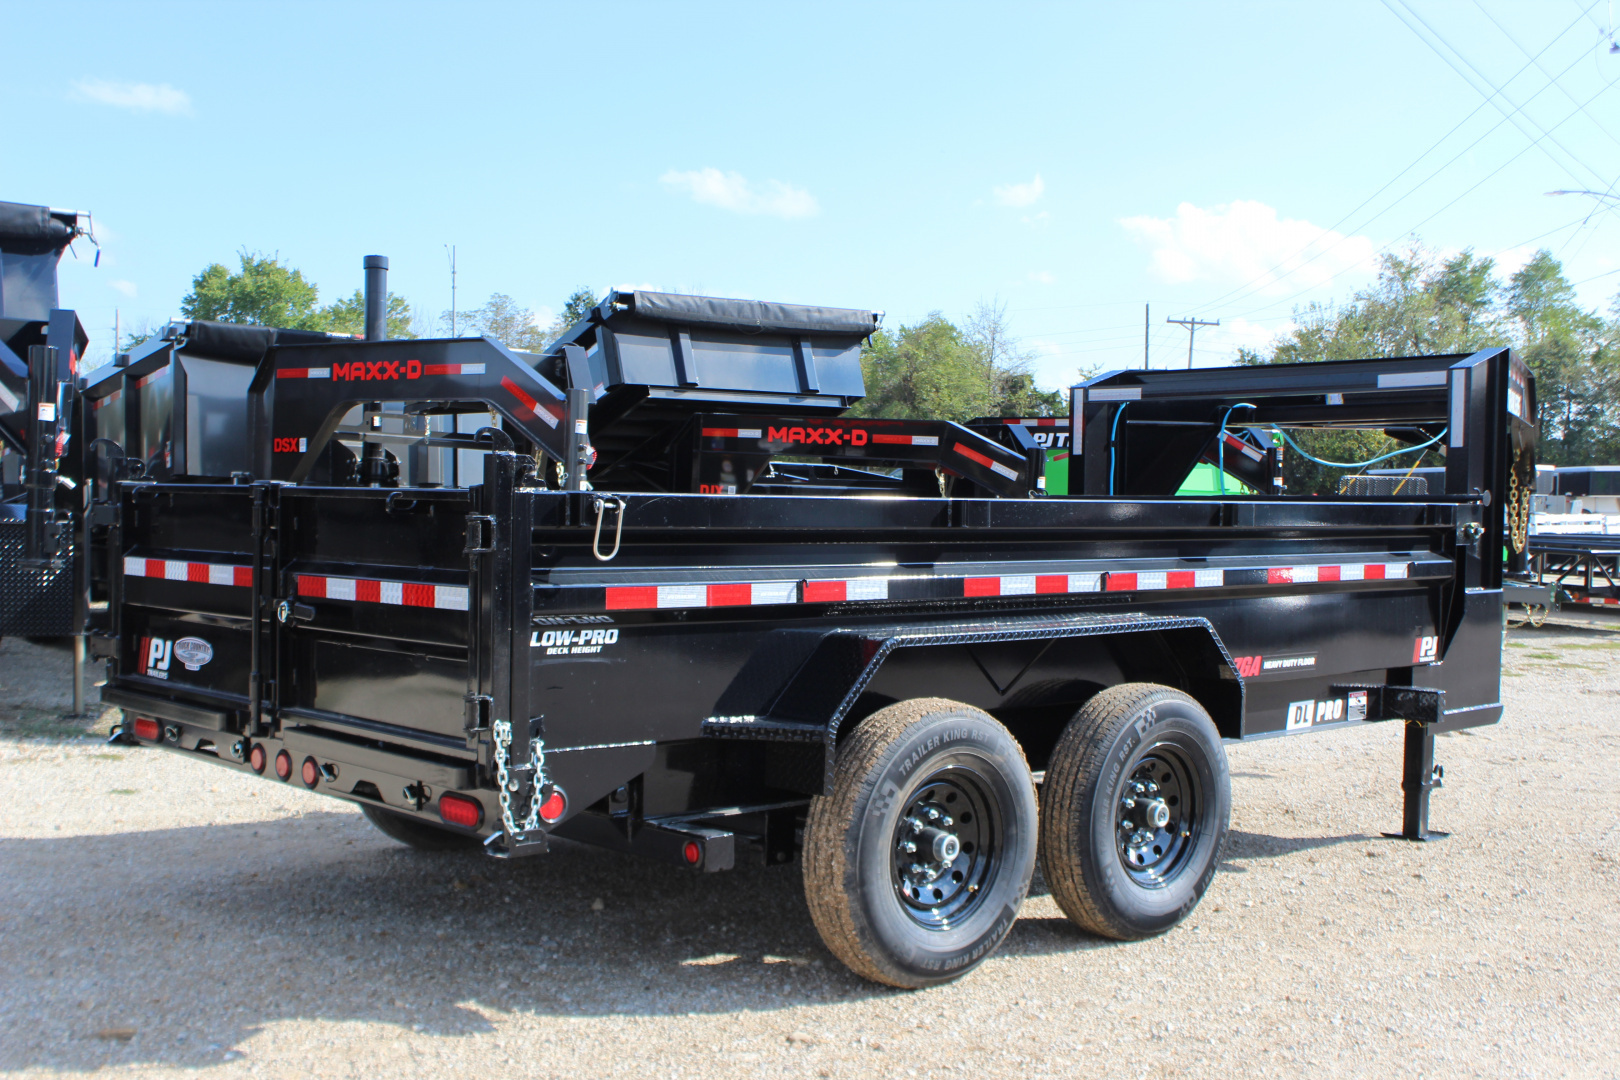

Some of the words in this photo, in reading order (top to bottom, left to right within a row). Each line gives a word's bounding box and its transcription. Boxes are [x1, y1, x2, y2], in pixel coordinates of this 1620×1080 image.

[332, 359, 422, 381] MAXX-D
[273, 437, 298, 453] DSX
[767, 426, 868, 446] MAXX-D
[529, 629, 619, 647] LOW-PRO
[1420, 635, 1439, 657] PJ
[148, 637, 173, 671] PJ
[546, 647, 569, 655] DECK
[571, 645, 603, 655] HEIGHT
[1263, 660, 1282, 670] HEAVY
[1282, 658, 1298, 668] DUTY
[1298, 656, 1316, 667] FLOOR
[146, 668, 169, 680] TRAILERS
[1293, 704, 1309, 725] DL
[1316, 698, 1343, 722] PRO
[899, 736, 940, 777] TRAILER
[943, 728, 968, 743] KING
[971, 729, 990, 744] RST
[1106, 762, 1120, 795] KING
[972, 918, 1009, 960] TRAILER
[944, 954, 970, 971] KING
